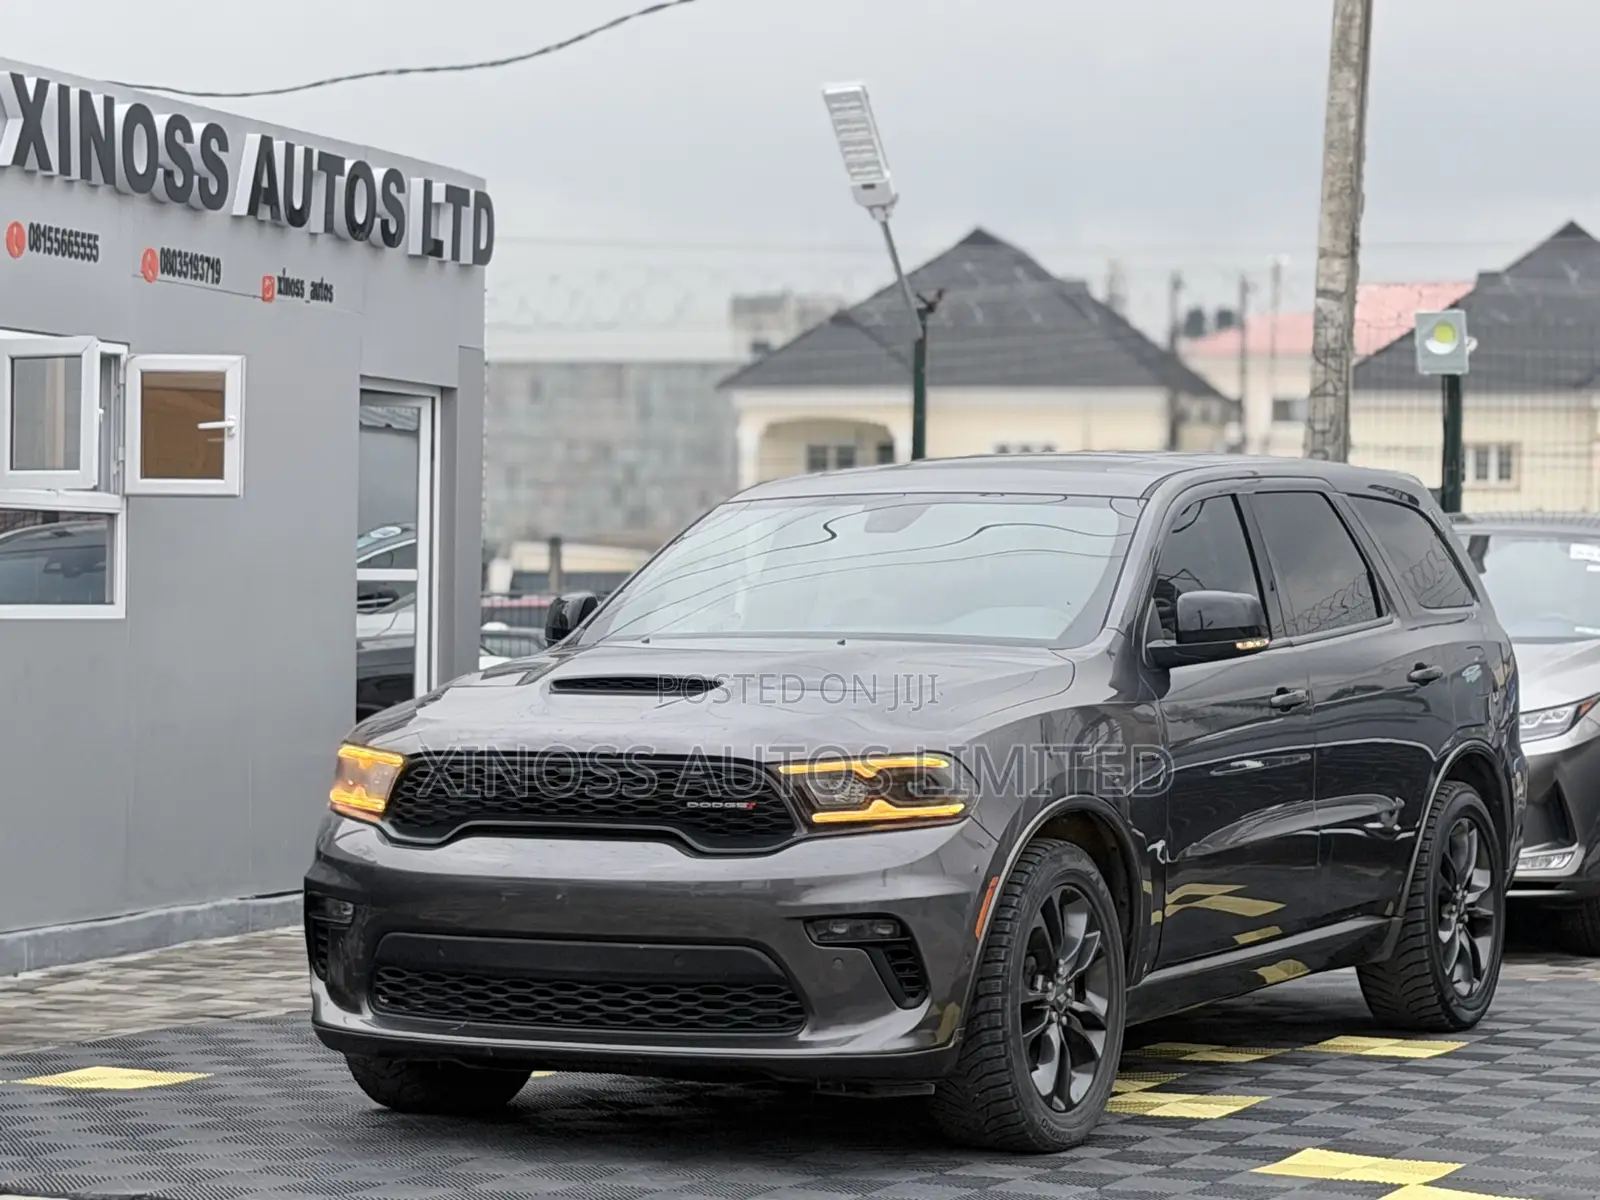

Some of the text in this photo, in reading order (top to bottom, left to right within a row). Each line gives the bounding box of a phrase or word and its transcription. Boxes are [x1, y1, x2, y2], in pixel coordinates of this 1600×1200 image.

[9, 72, 495, 266] XINOSS AUTOS LTD
[28, 222, 100, 263] 08155665555
[160, 247, 222, 285] 08035193719
[276, 267, 334, 304] xinoss_autos
[686, 801, 748, 809] DODGE
